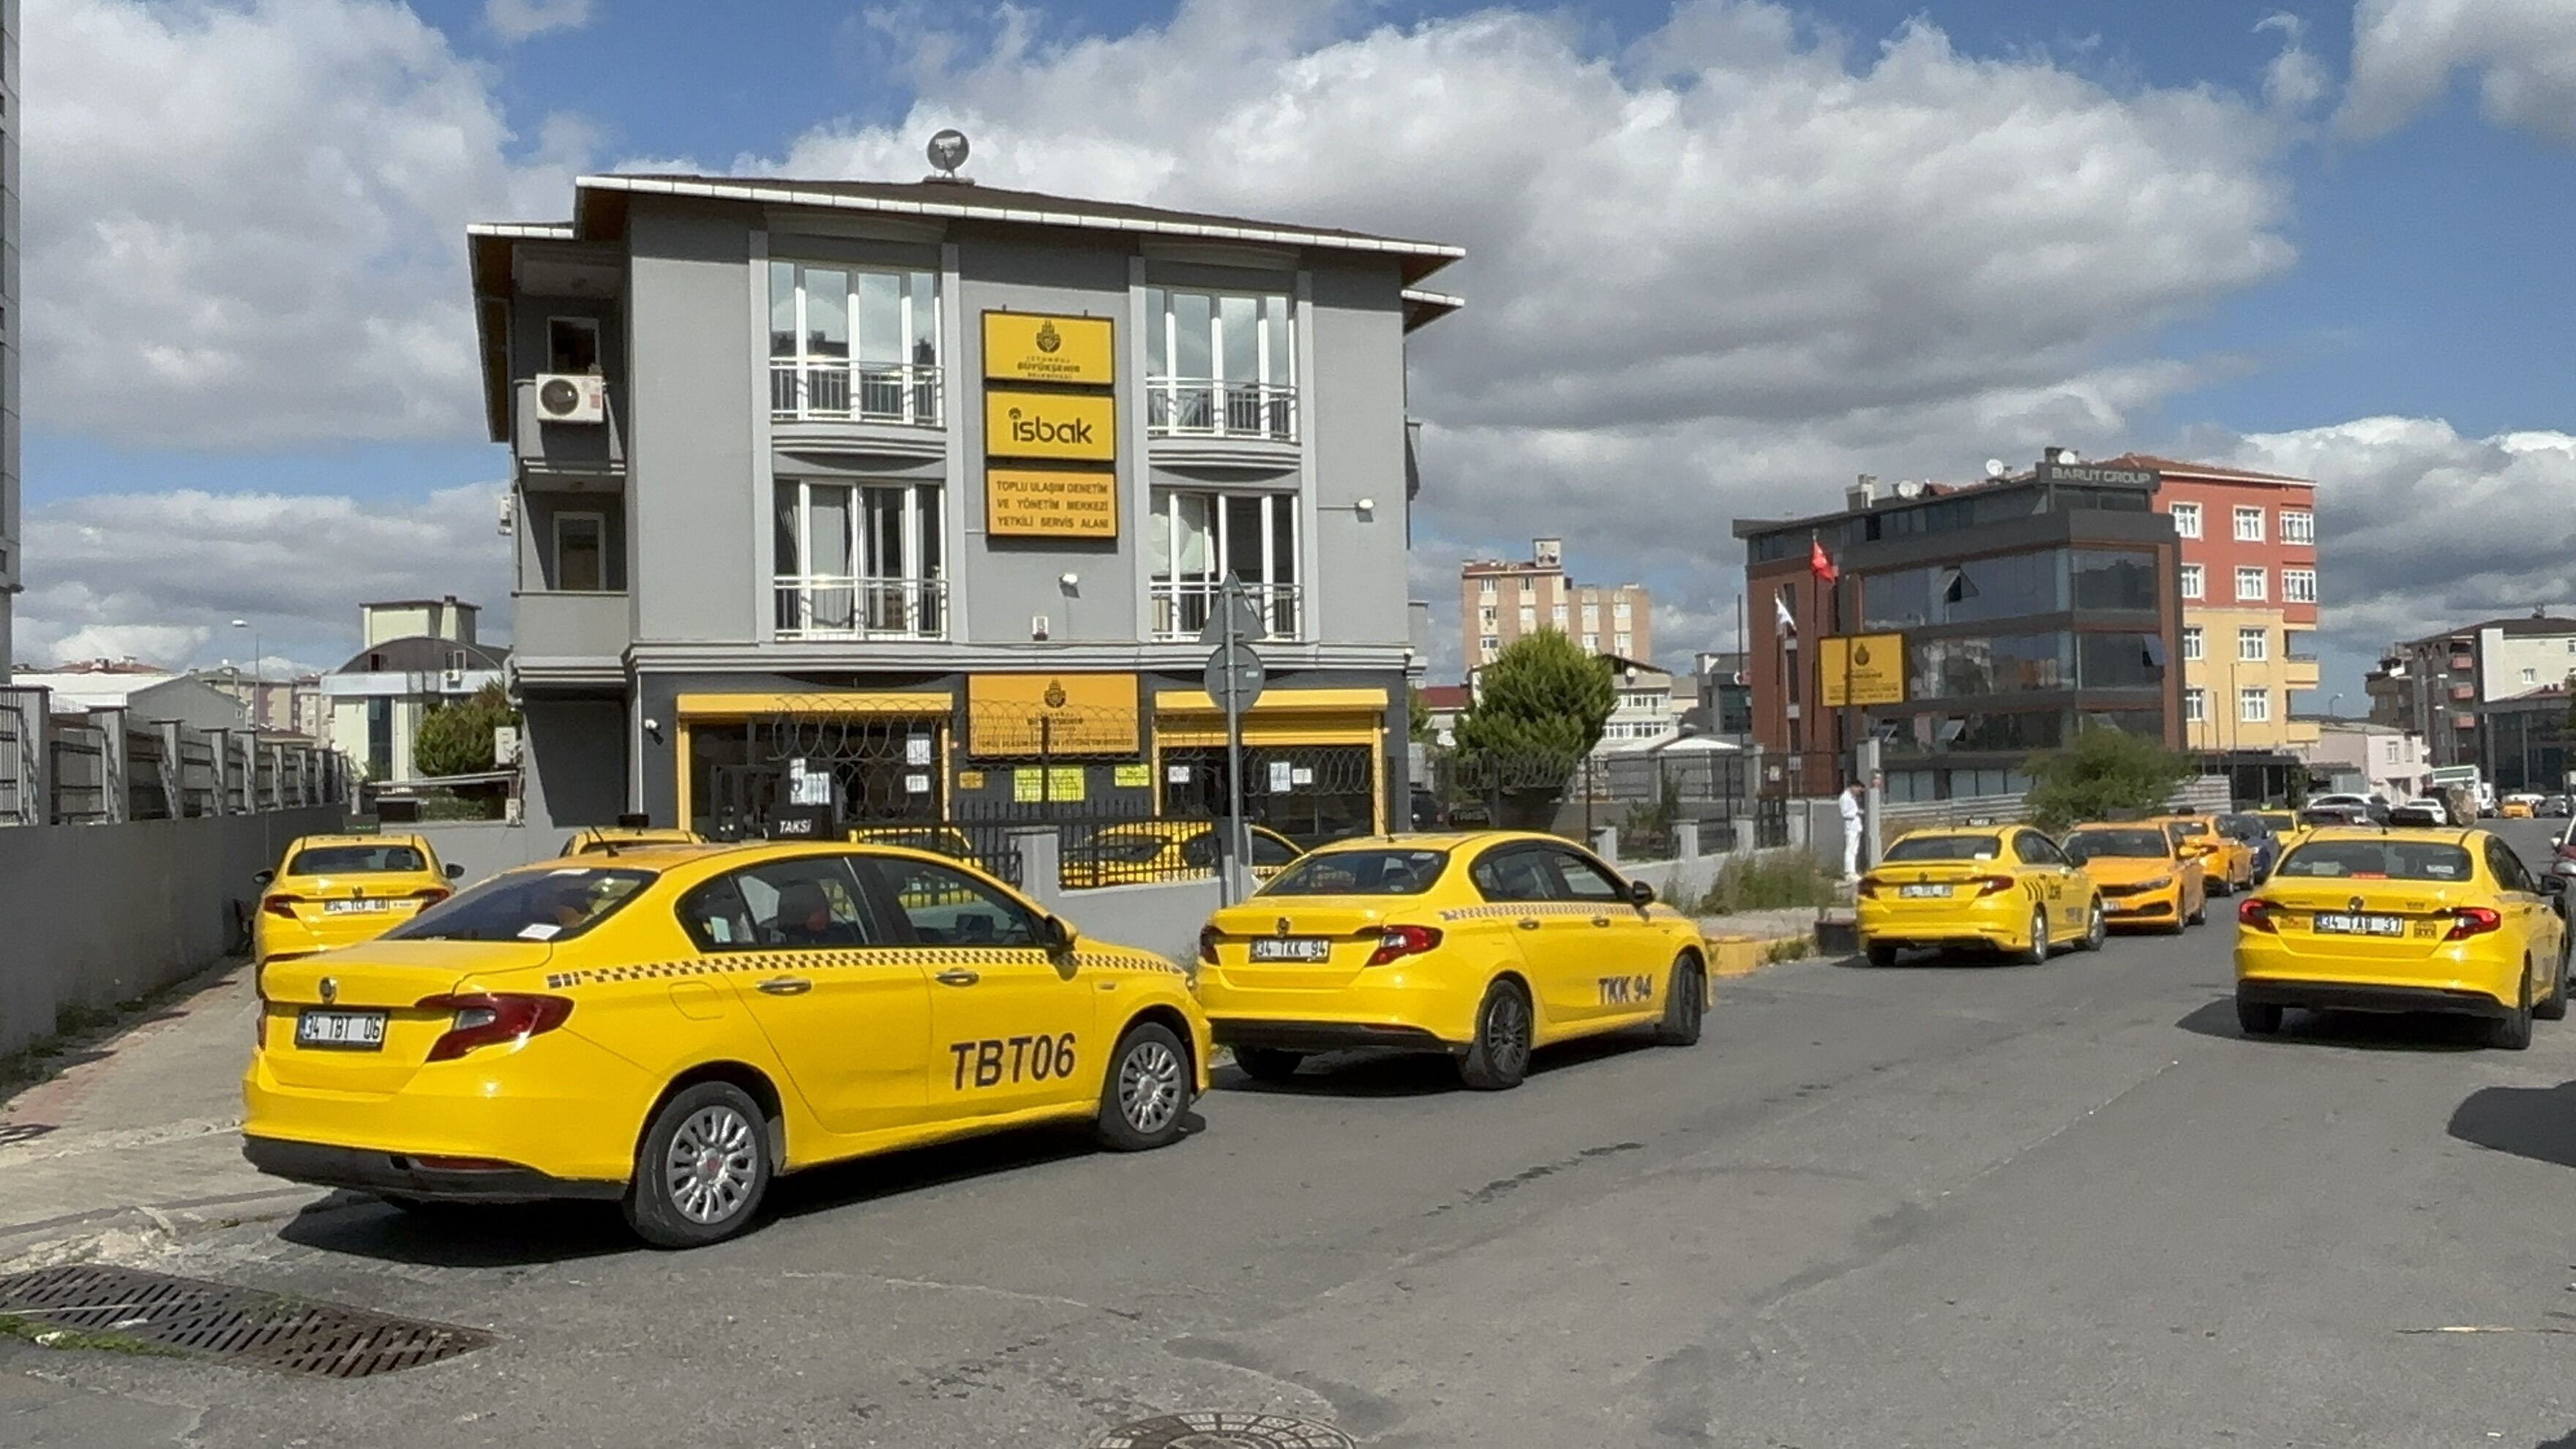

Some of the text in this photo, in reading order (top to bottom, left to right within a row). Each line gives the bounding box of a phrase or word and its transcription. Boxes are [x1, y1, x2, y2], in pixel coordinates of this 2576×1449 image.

[2051, 467, 2151, 483] BARUT GROUP
[996, 481, 1107, 494] TOPLU ULAŞIM DENETİM
[997, 498, 1009, 509] VE
[1017, 497, 1059, 510] YÖNETİM
[997, 515, 1109, 528] YETKİLİ SERVİS ALANI
[2324, 915, 2338, 929] 34
[2384, 916, 2400, 931] 37
[1257, 940, 1327, 956] 34 TKK 94
[1598, 973, 1652, 1004] TKK 94
[304, 1015, 381, 1039] 34 TBT 06
[950, 1032, 1076, 1090] TBT06
